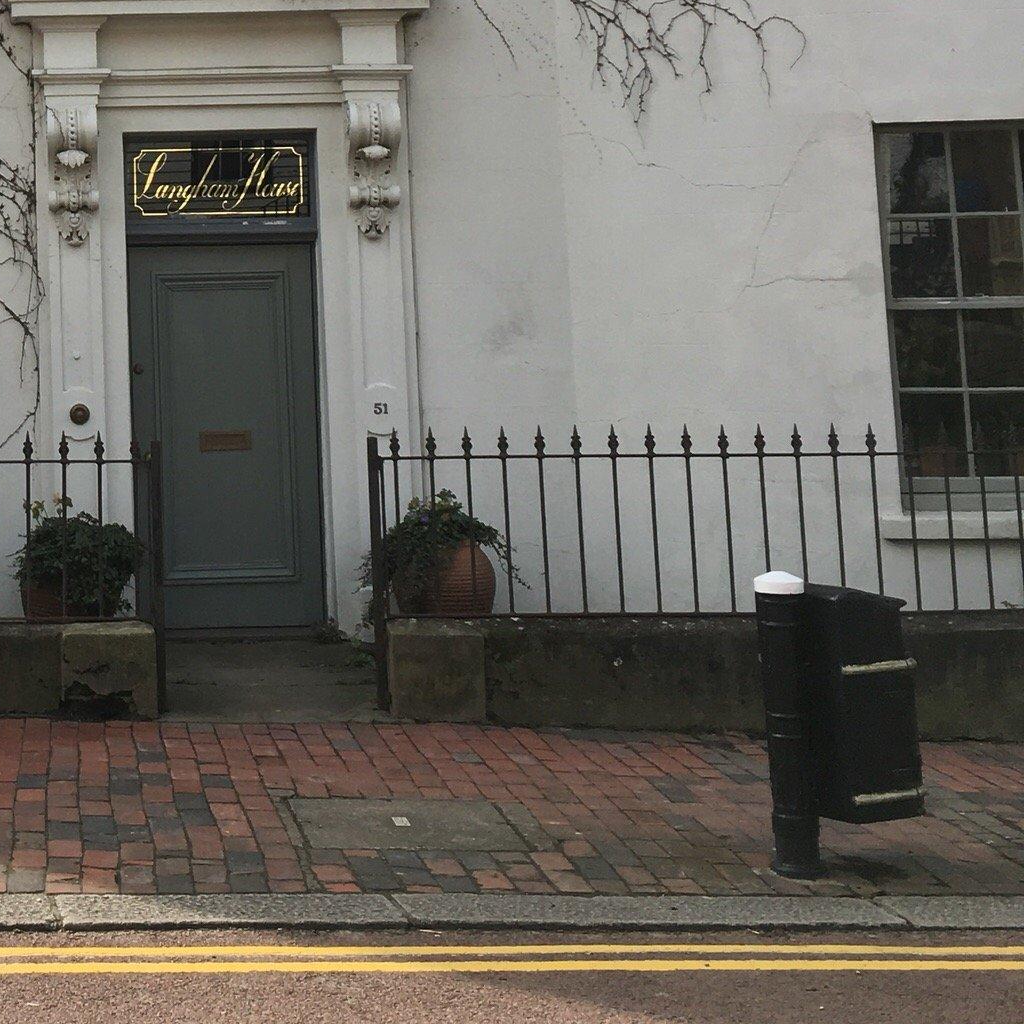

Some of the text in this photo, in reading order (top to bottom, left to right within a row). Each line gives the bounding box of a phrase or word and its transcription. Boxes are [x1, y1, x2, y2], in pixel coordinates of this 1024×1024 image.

[137, 151, 300, 214] Langham House
[373, 402, 389, 415] 51
